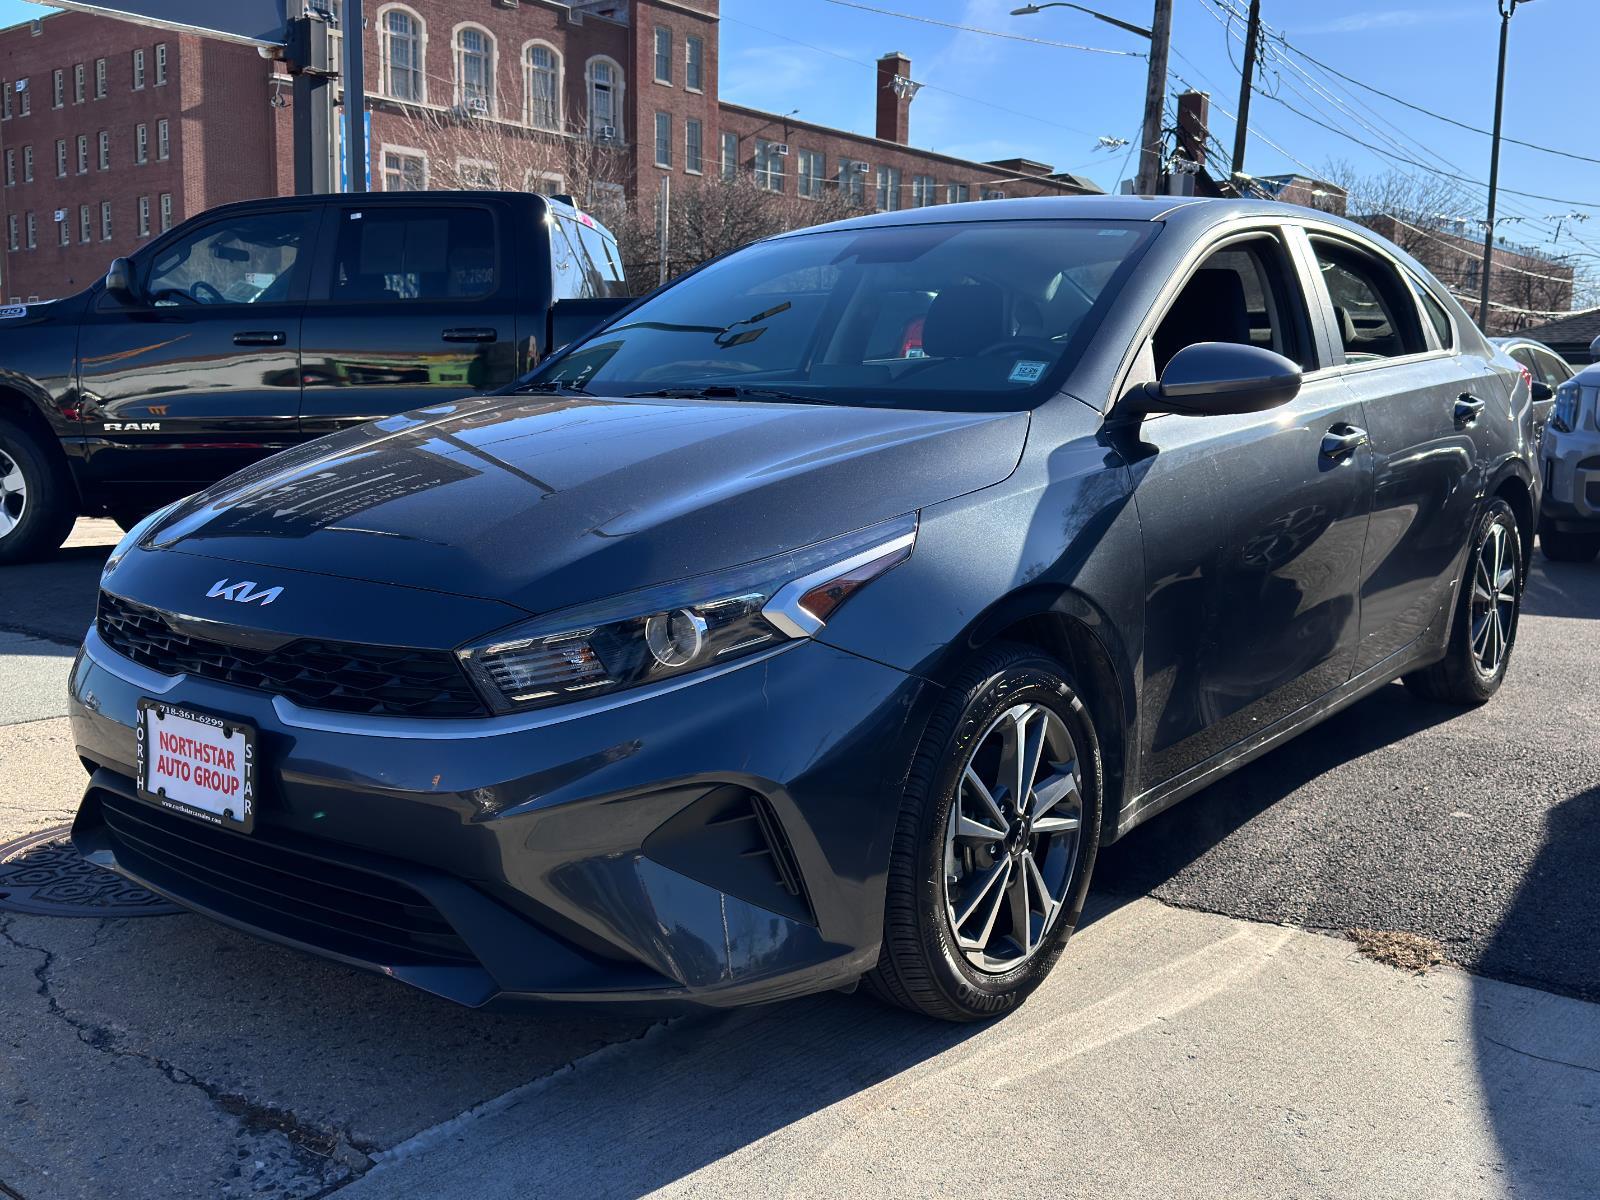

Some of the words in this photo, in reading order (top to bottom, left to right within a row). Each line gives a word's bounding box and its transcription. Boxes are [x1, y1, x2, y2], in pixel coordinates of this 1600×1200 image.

[103, 422, 161, 431] RAM
[205, 578, 285, 606] KIA
[159, 704, 225, 728] 718-361-6299
[136, 709, 145, 791] NORTH
[159, 730, 236, 772] NORTHSTAR
[156, 754, 191, 782] AUTO
[193, 765, 240, 797] GROUP
[243, 743, 253, 816] STAR
[956, 983, 1017, 1012] KUMHO
